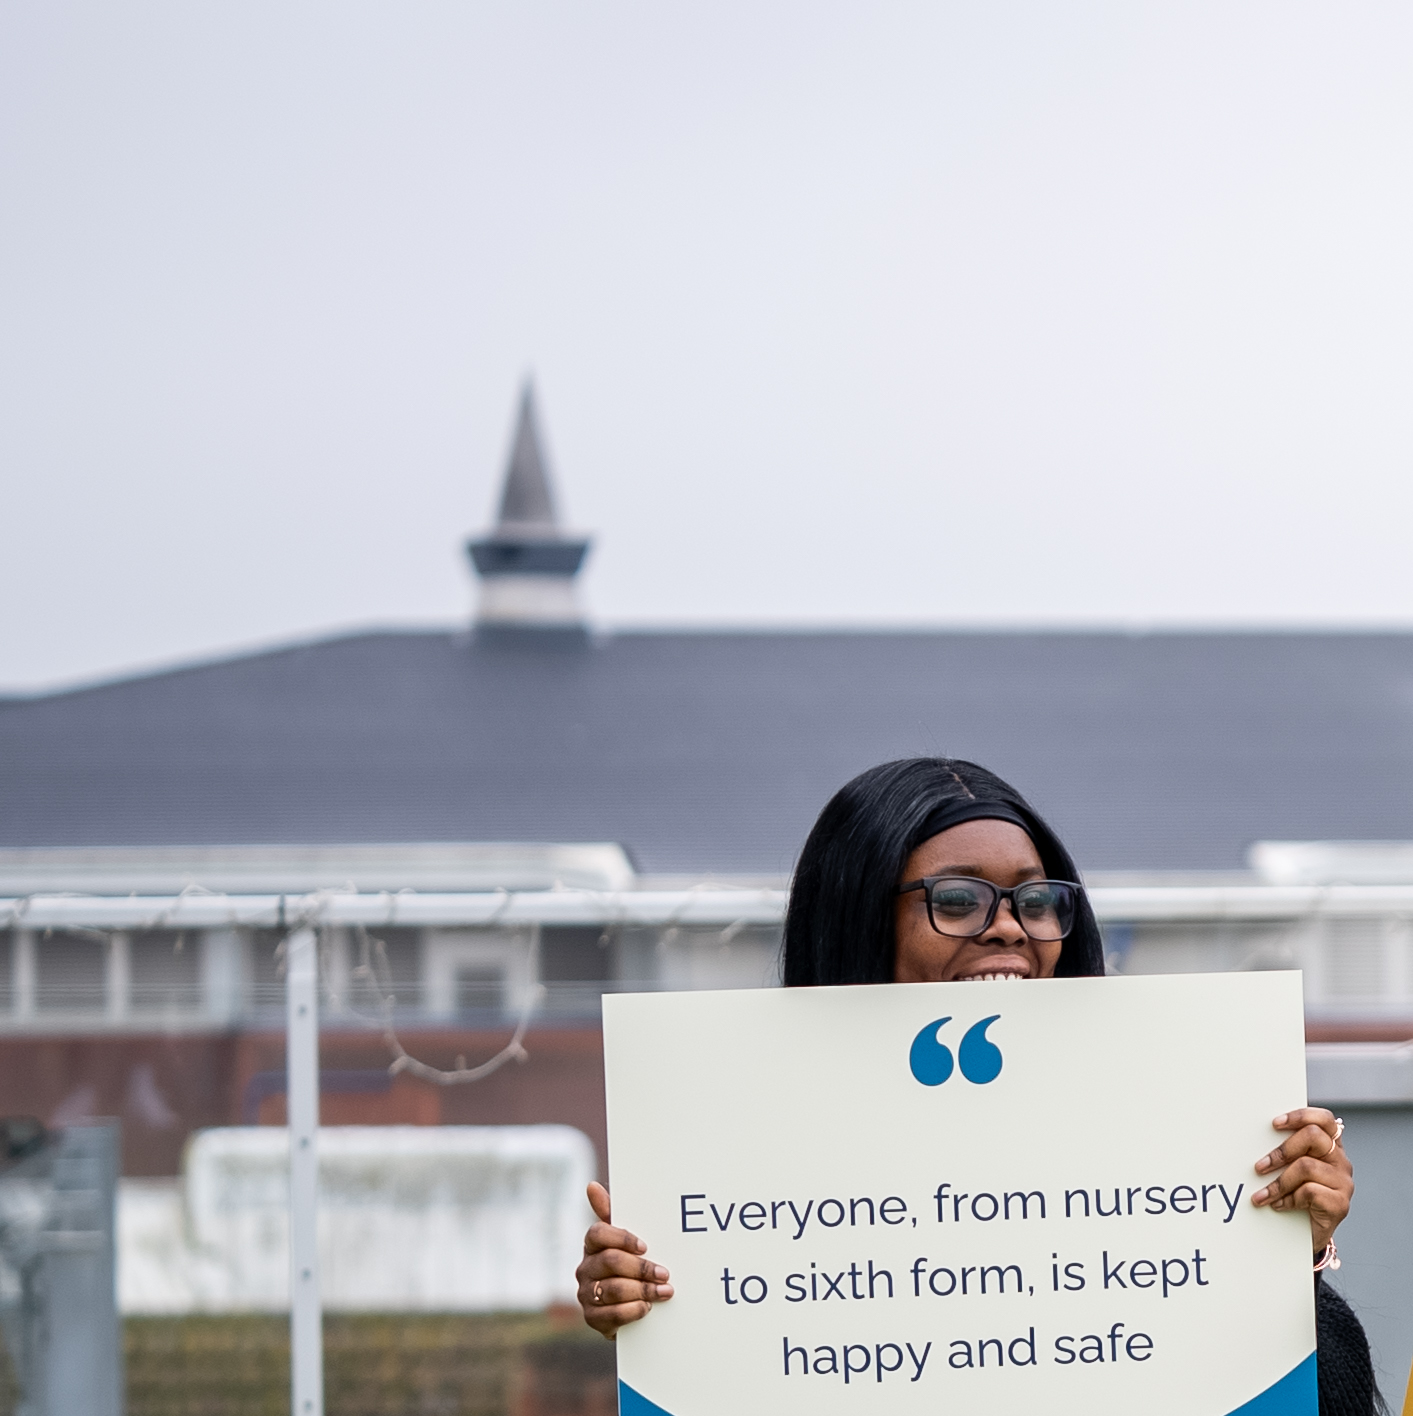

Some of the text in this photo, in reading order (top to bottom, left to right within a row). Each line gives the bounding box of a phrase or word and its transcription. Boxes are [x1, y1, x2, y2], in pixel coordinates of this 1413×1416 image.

[680, 1183, 1245, 1241] Everyone, from nursery
[720, 1248, 1210, 1305] to sixth form, is kept
[782, 1322, 1154, 1385] happy and safe
